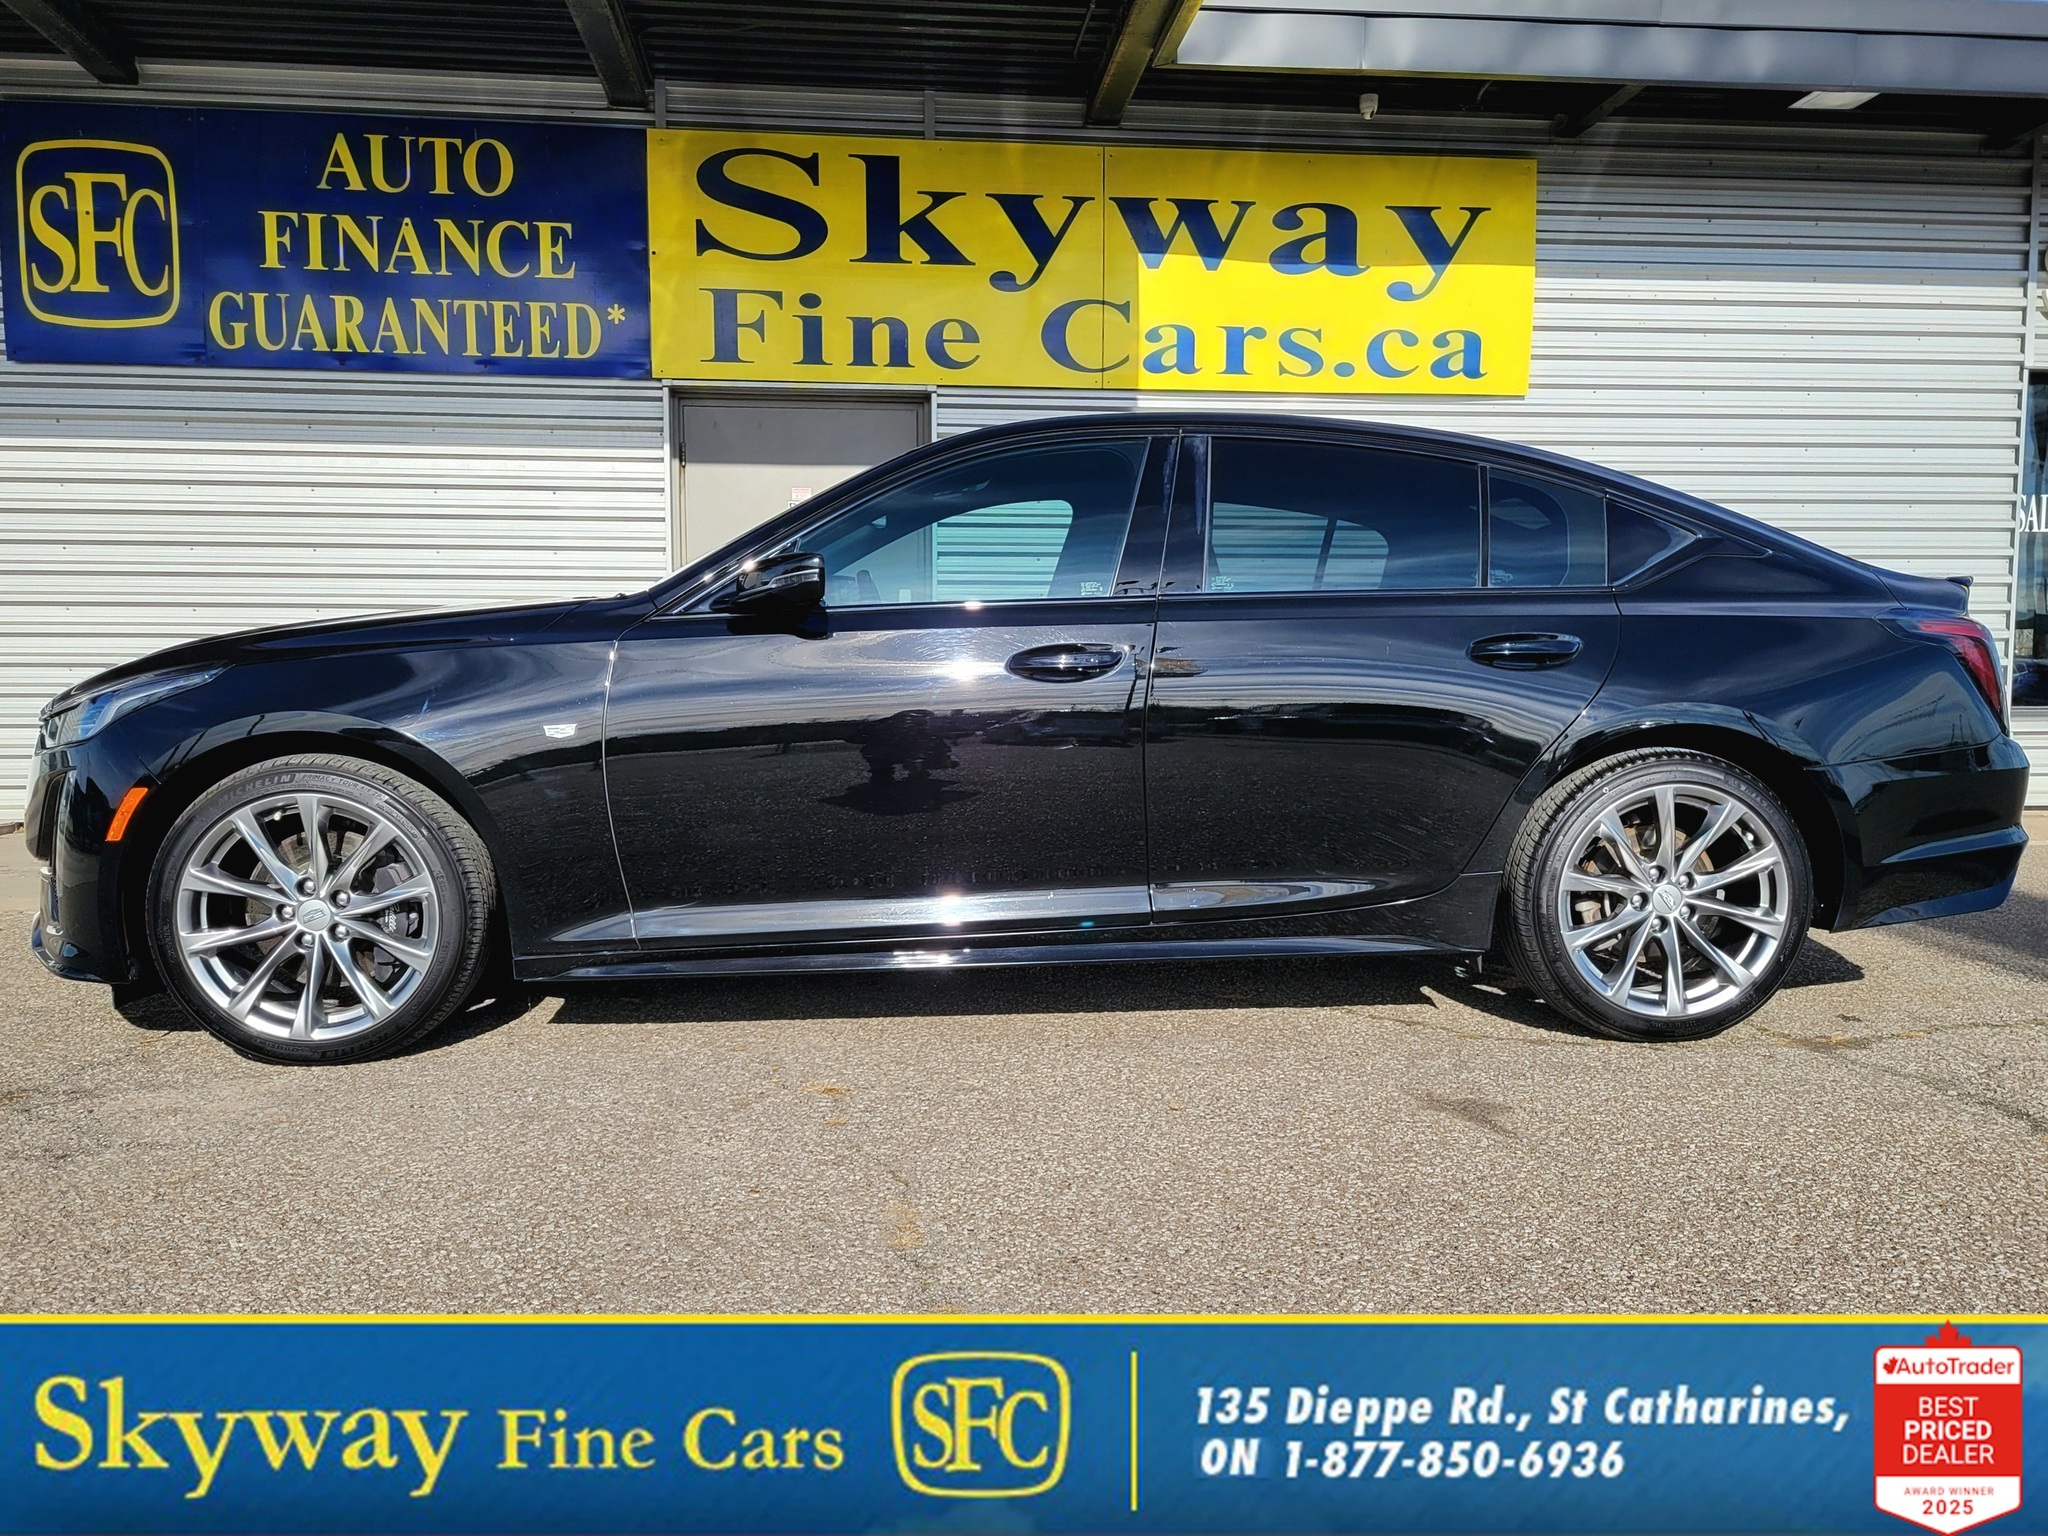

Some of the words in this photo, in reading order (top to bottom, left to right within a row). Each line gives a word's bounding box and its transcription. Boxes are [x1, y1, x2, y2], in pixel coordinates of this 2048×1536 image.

[318, 131, 515, 197] AUTO
[29, 172, 169, 297] SFC
[258, 210, 575, 279] FINANCE
[695, 147, 1491, 302] Skyway
[700, 288, 980, 370] Fine
[1041, 299, 1486, 380] Cars.ca
[302, 774, 335, 783] PRIMACY
[339, 779, 359, 789] TOUR
